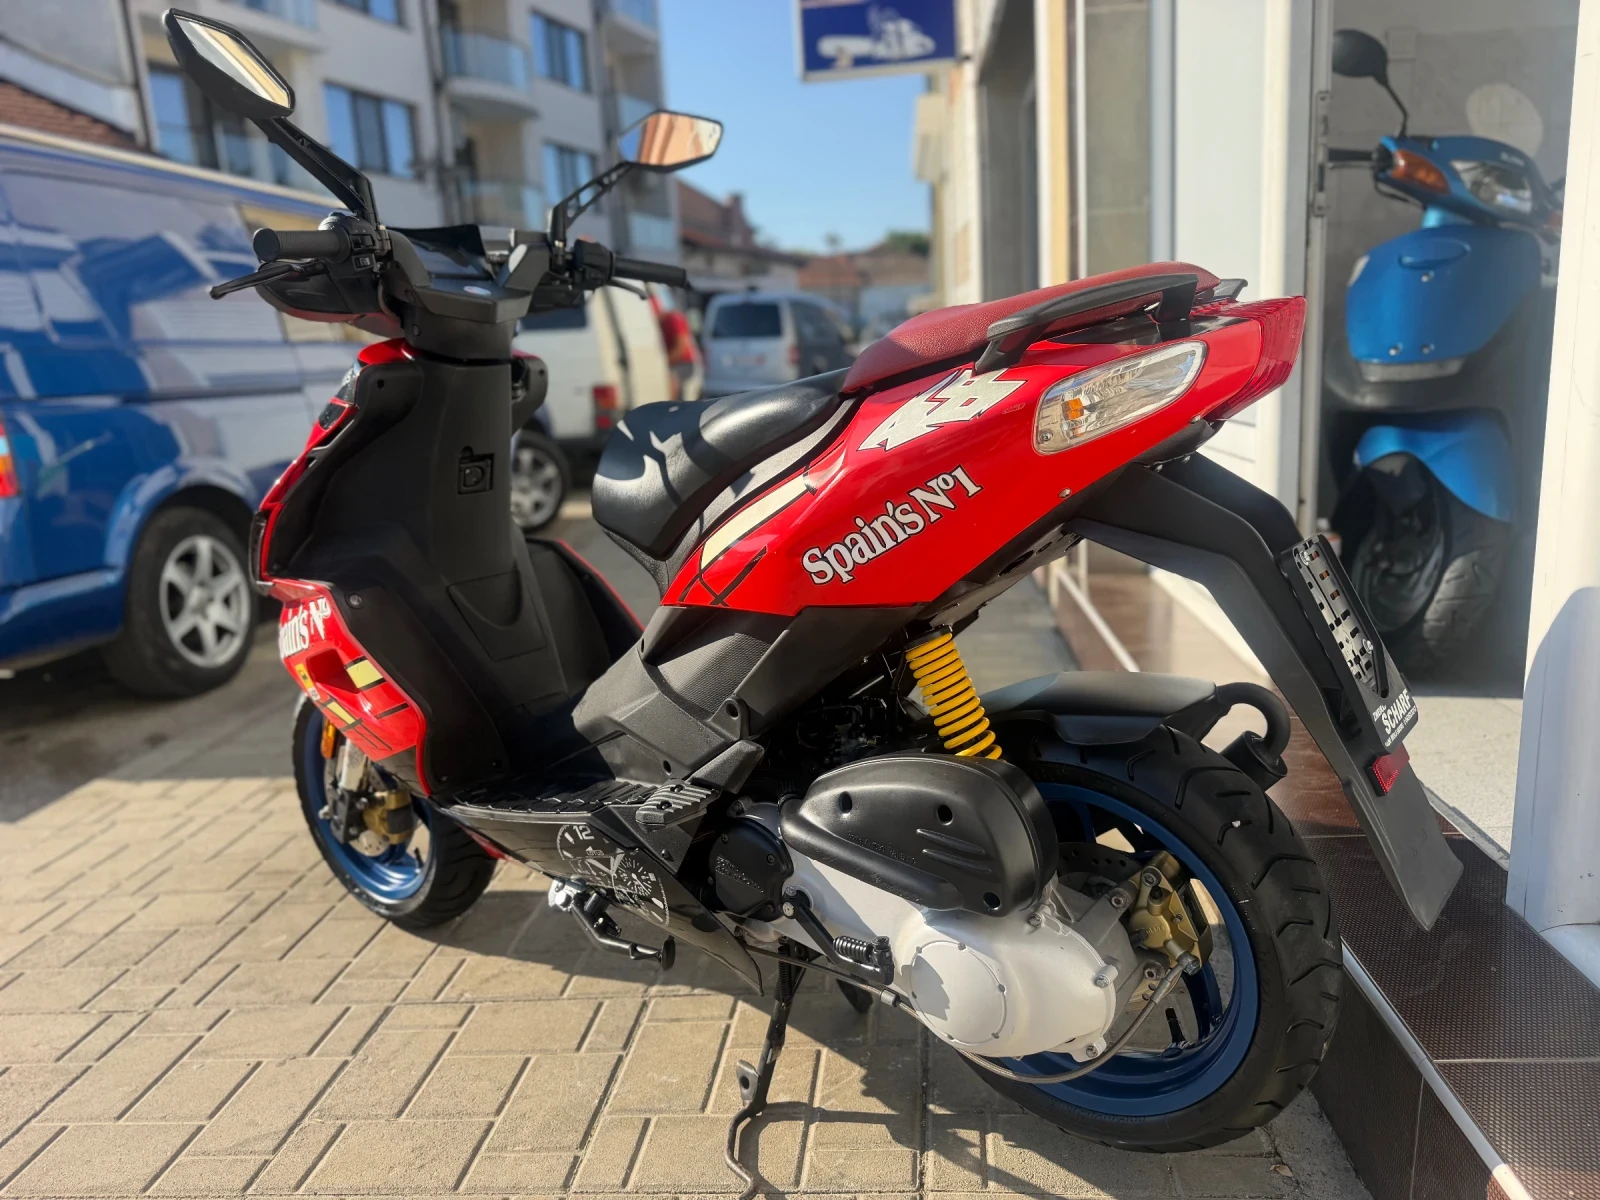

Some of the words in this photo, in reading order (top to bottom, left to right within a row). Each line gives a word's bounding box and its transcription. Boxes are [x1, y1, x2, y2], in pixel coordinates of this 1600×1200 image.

[802, 501, 925, 585] Spain's
[1381, 688, 1411, 735] SCHARF
[572, 825, 595, 840] 12
